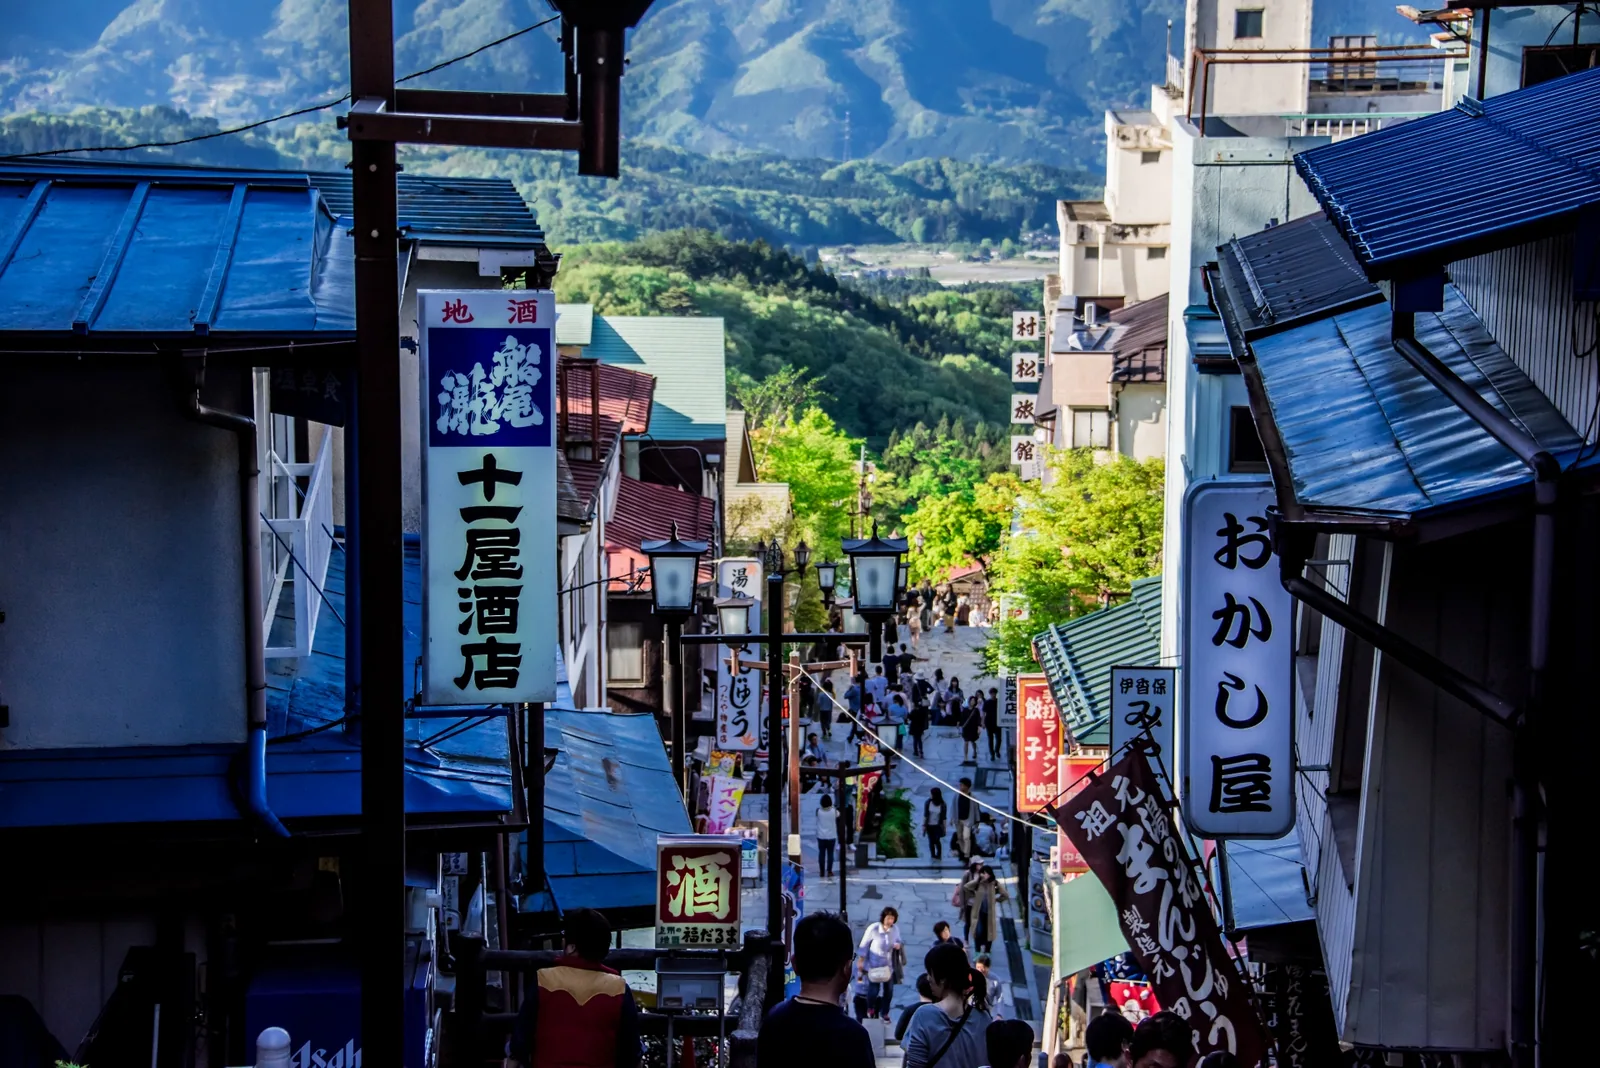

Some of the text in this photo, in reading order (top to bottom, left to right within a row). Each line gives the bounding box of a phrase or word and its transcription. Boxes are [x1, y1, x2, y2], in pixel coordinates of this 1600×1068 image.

[442, 299, 538, 324] 地酒
[1014, 316, 1037, 462] 村松旅館
[453, 453, 523, 691] 十一屋酒店
[1119, 678, 1166, 695] 伊香保
[1208, 511, 1273, 814] おかし屋
[1025, 697, 1042, 761] 餃子
[1041, 689, 1057, 776] 手打ラーメン
[666, 851, 733, 920] 酒
[681, 926, 738, 945] 福だるま
